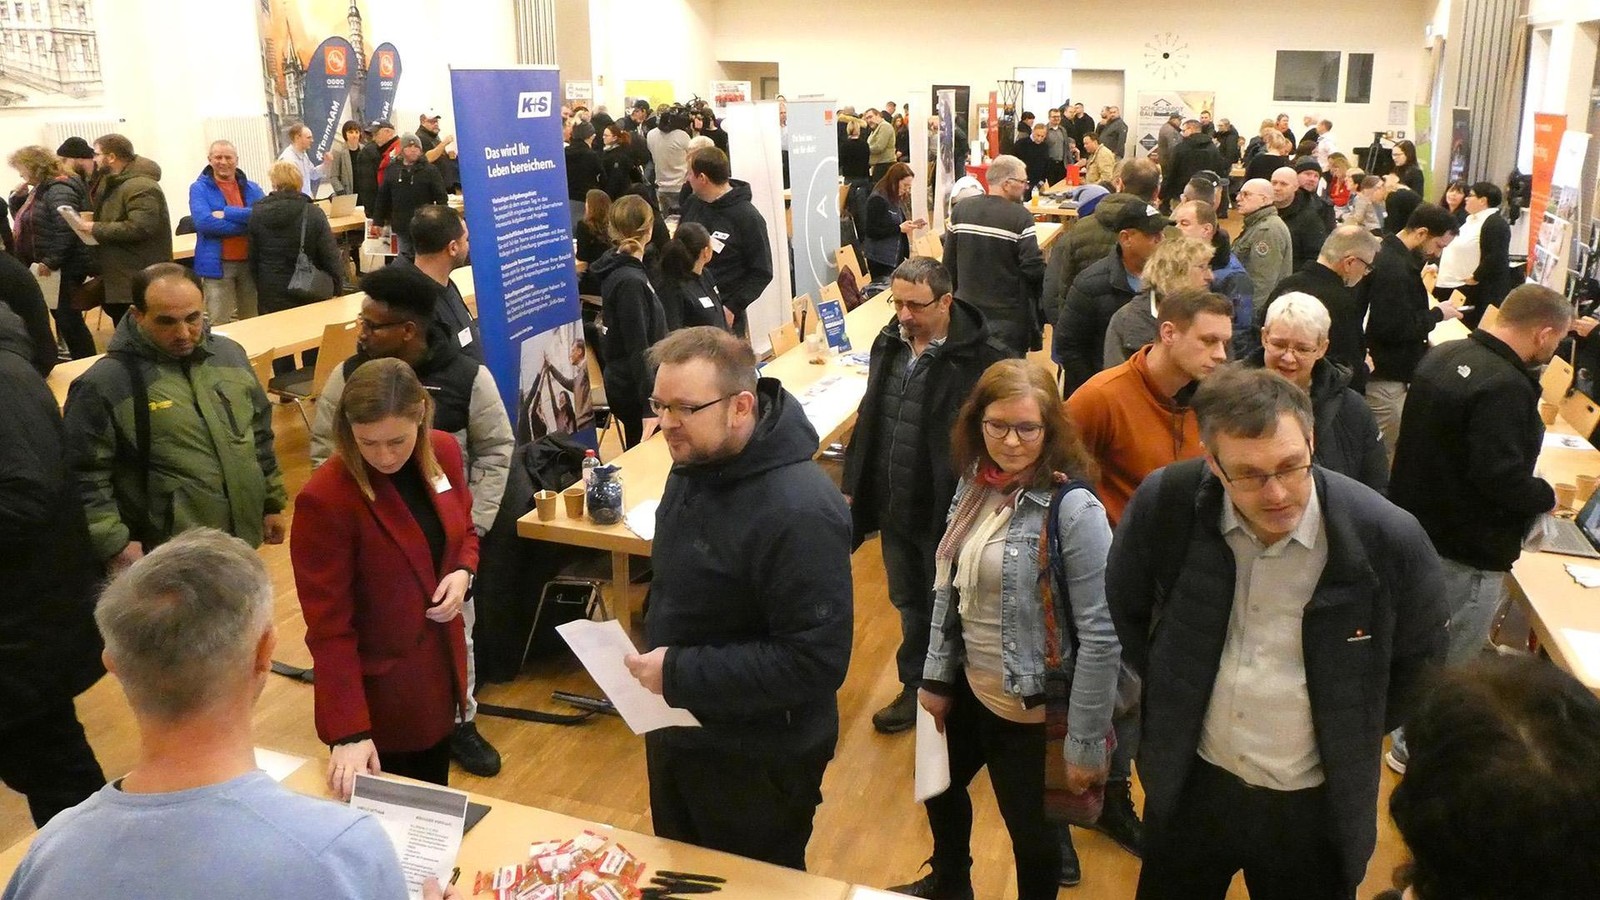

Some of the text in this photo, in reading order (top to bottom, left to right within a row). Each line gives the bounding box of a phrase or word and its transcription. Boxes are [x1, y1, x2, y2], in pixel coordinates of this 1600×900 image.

[522, 96, 548, 113] K+S
[485, 142, 530, 160] Das wird Ihr
[487, 157, 557, 178] Leben bereichern.
